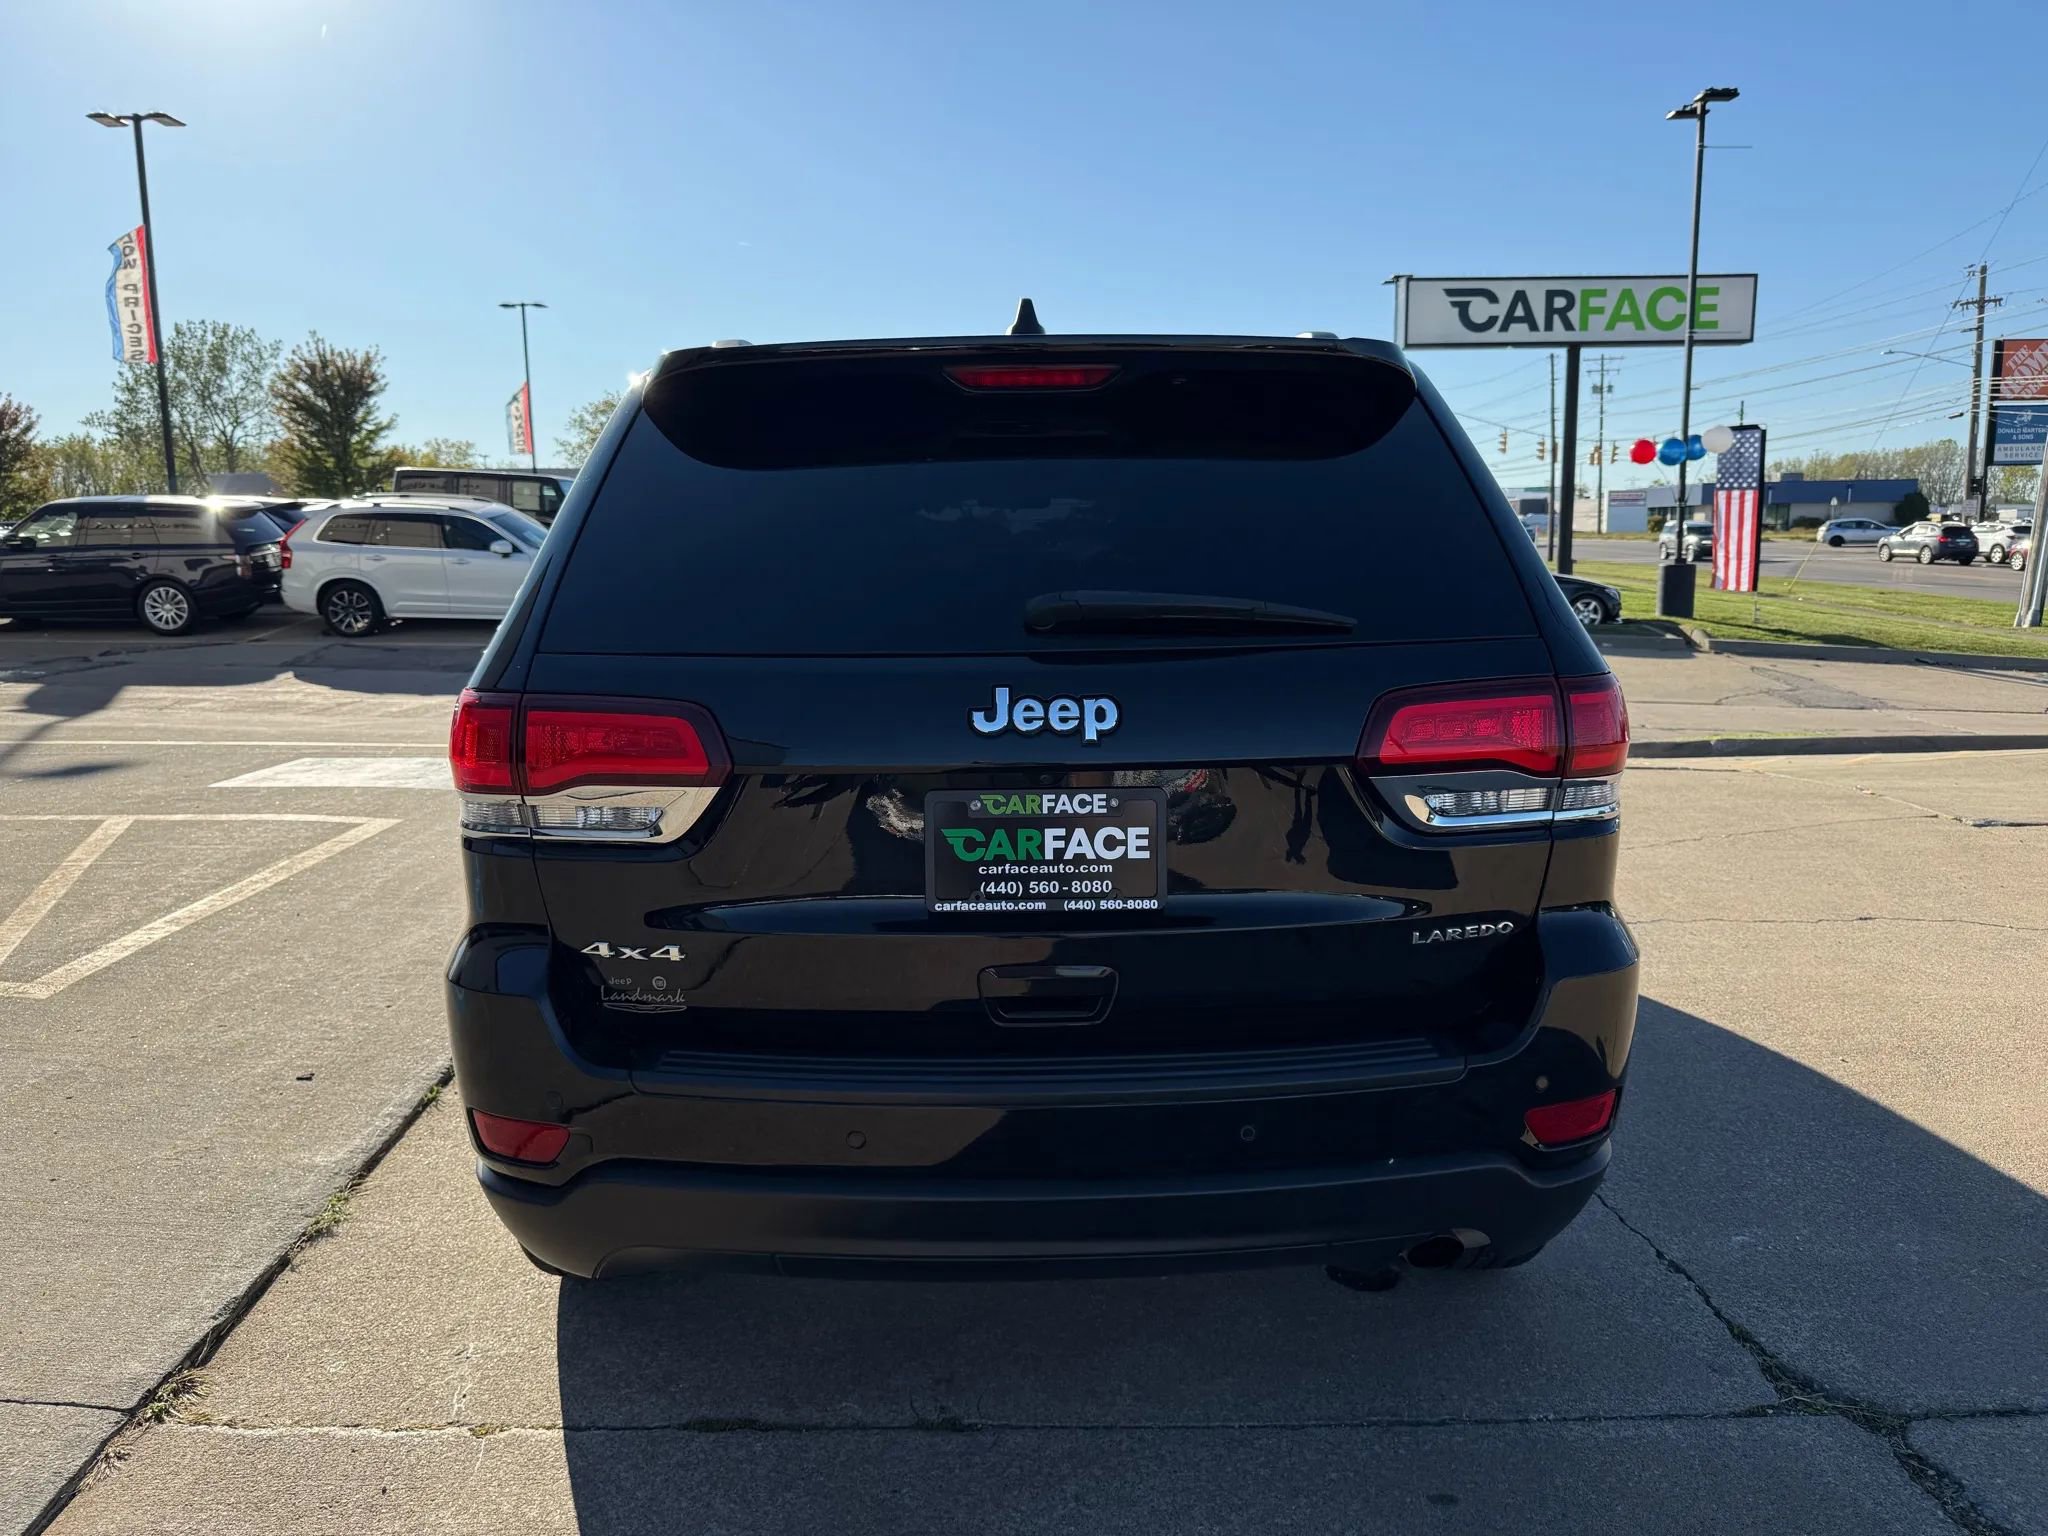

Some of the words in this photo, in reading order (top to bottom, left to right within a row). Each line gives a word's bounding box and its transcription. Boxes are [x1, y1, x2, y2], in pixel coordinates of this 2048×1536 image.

[1442, 286, 1720, 333] CARFACE
[971, 686, 1119, 741] Jeep
[979, 793, 1107, 815] CARFACE
[940, 827, 1150, 862] CARFACE
[978, 863, 1113, 875] carfaceauto.com
[980, 882, 1023, 896] (440)
[934, 900, 1047, 912] carfaceauto.com
[1063, 900, 1096, 911] (440)
[1099, 899, 1158, 910] 560-8080
[1412, 921, 1514, 945] LAREDO
[580, 941, 686, 961] 4x4
[600, 984, 686, 1003] Landmark
